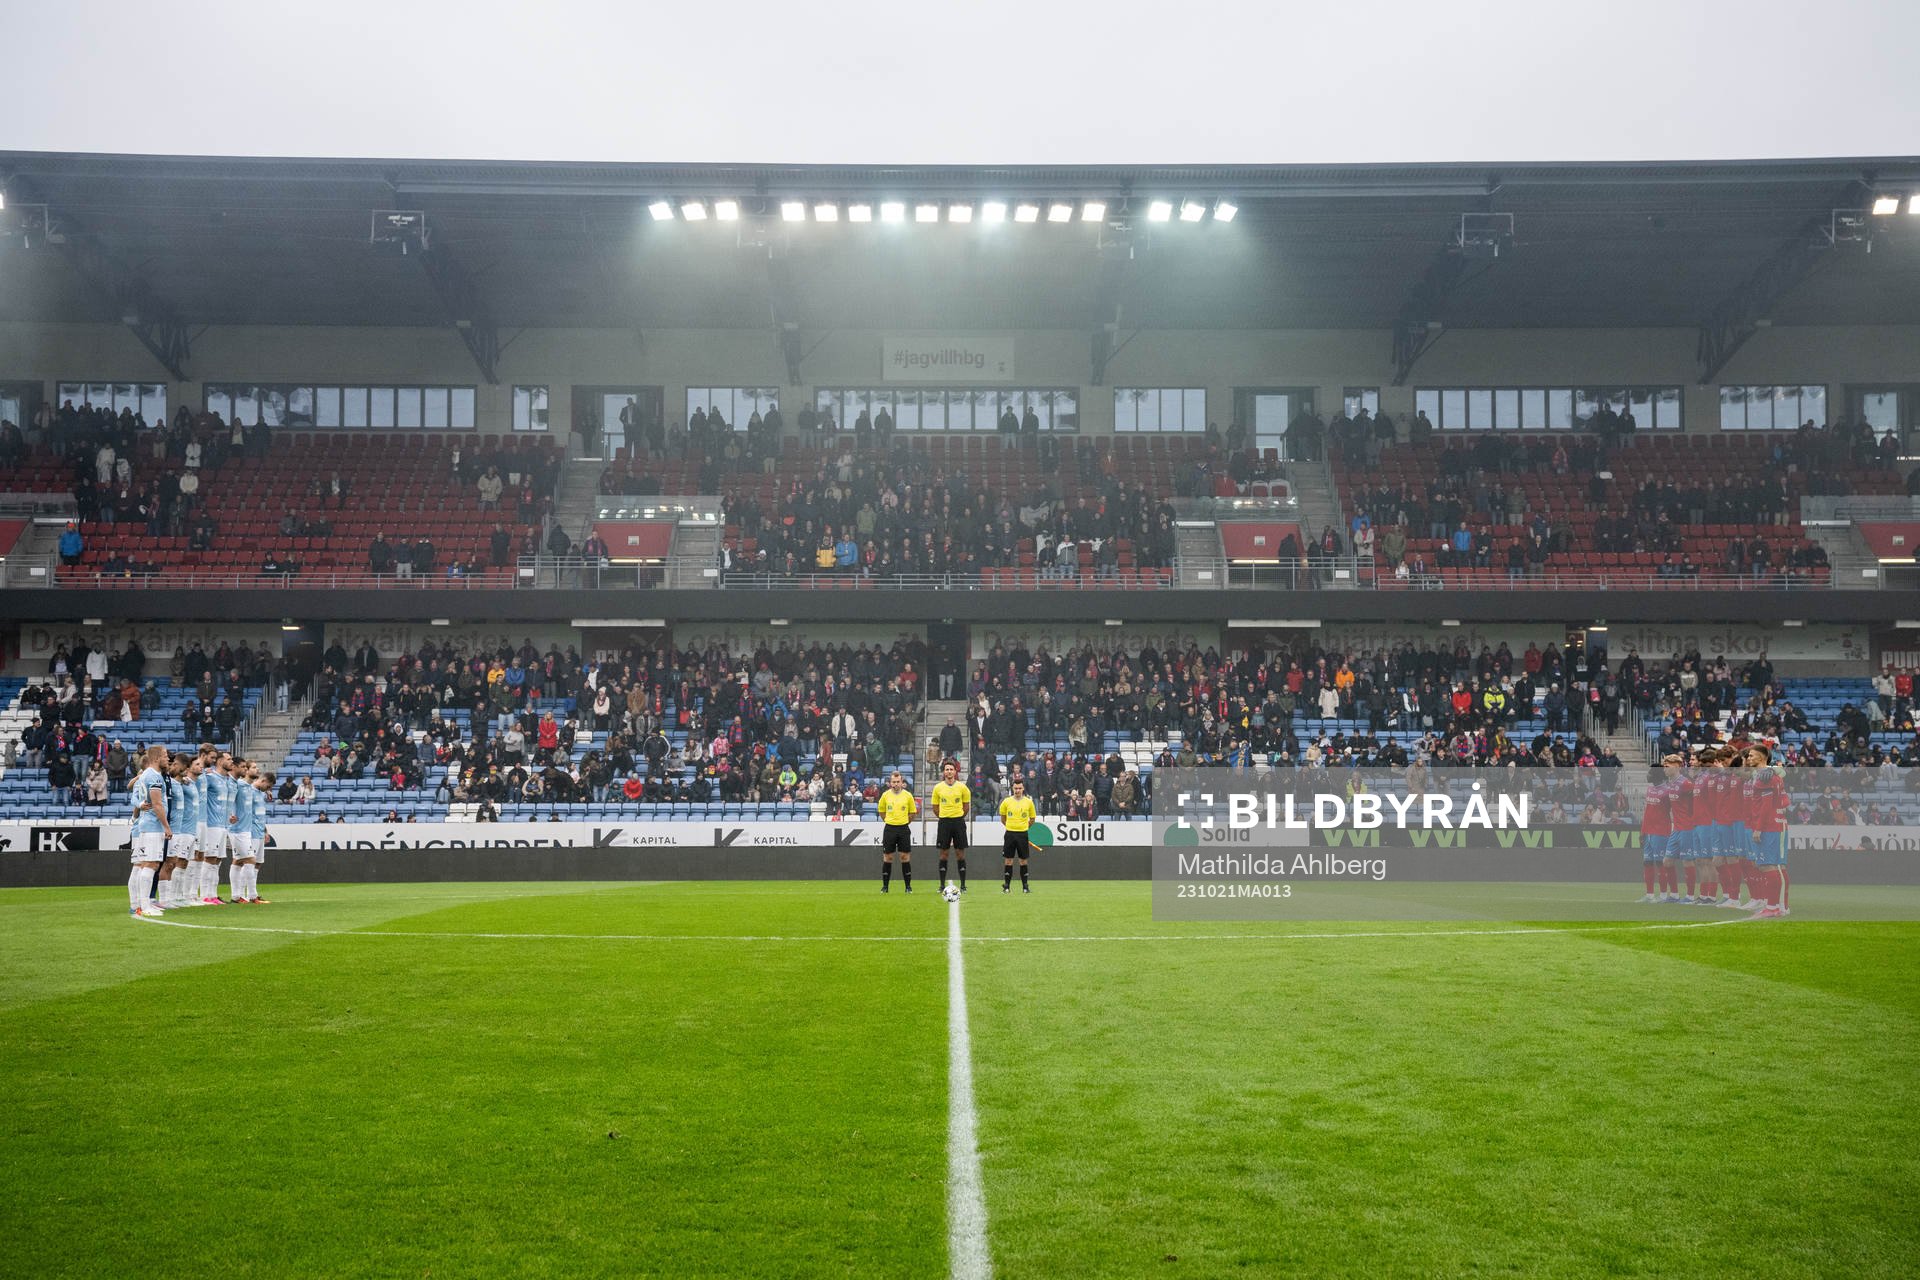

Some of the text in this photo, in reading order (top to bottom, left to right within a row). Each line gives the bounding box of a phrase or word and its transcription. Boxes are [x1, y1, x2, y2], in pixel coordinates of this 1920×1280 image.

[894, 349, 985, 368] #jagvillhbg
[1710, 629, 1774, 655] skor
[633, 836, 677, 845] KAPITAL
[754, 836, 798, 845] KAPITAL
[1057, 823, 1105, 842] Solid
